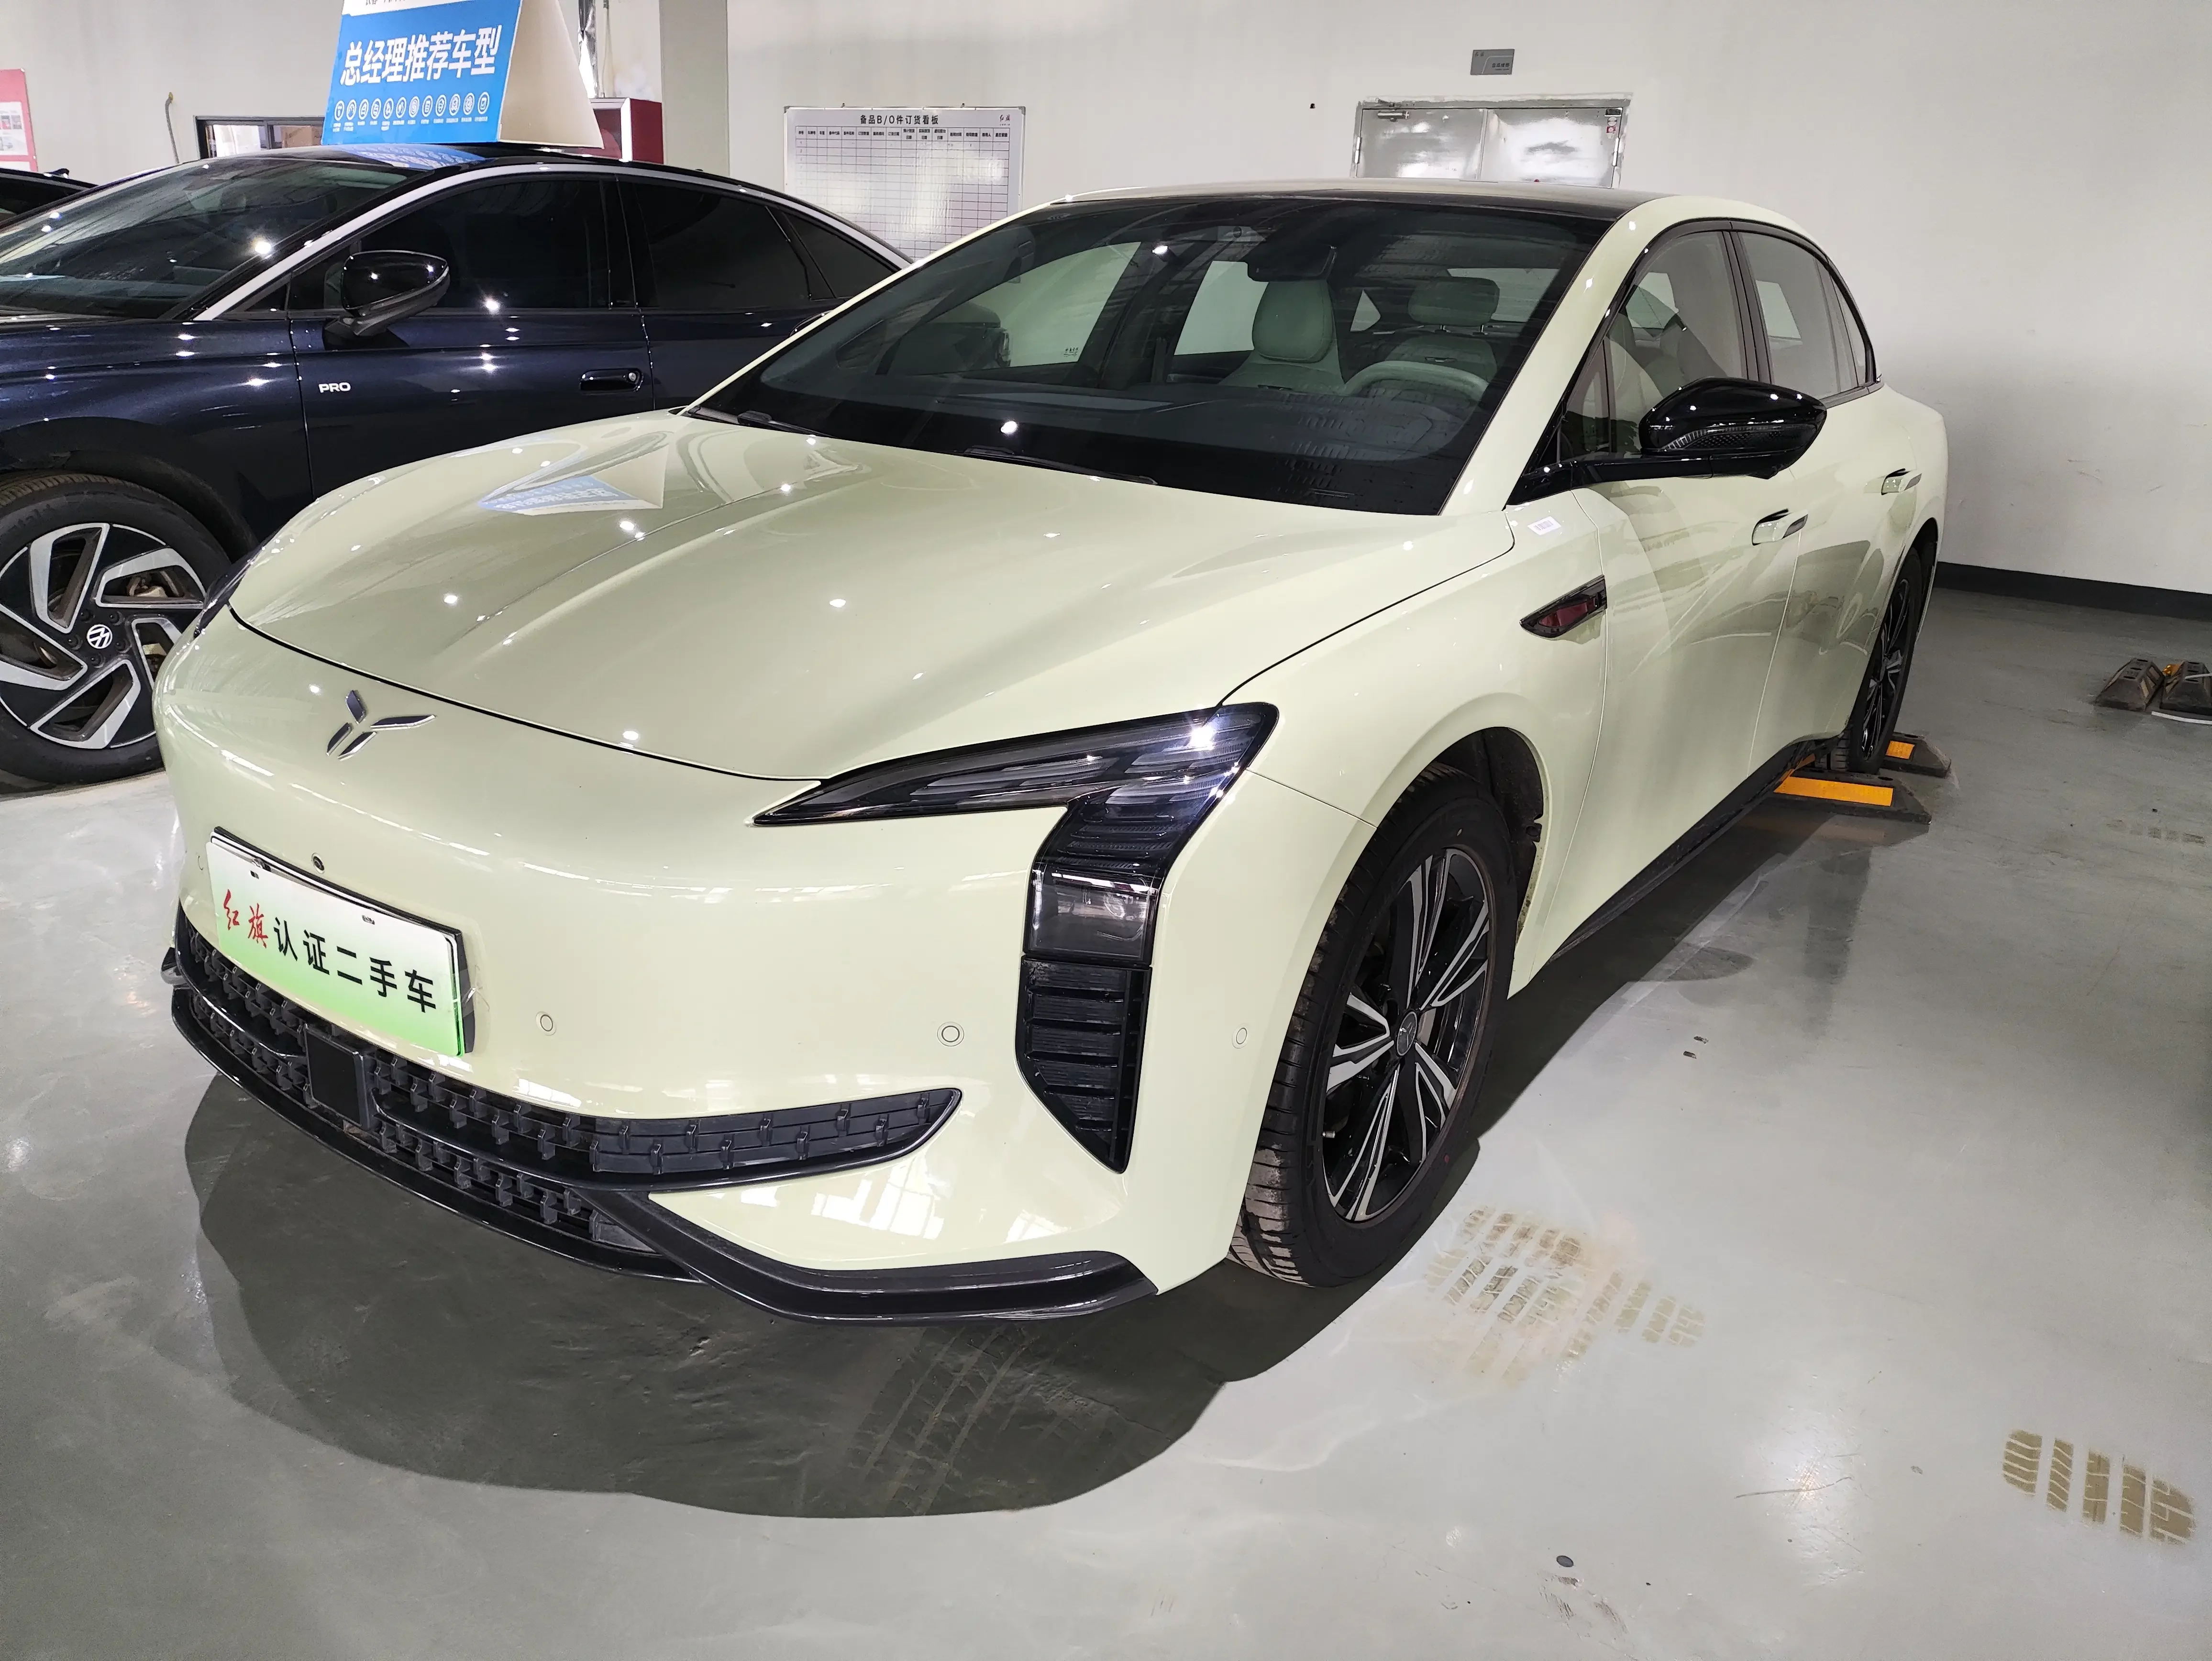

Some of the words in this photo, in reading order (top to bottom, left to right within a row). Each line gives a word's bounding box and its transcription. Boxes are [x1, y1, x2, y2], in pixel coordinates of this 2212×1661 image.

[340, 24, 502, 86] 总经理推荐车型
[860, 114, 939, 125] 备品B/O件订货看板
[318, 382, 351, 393] PRO
[223, 889, 436, 1013] 红旗认证二手车
